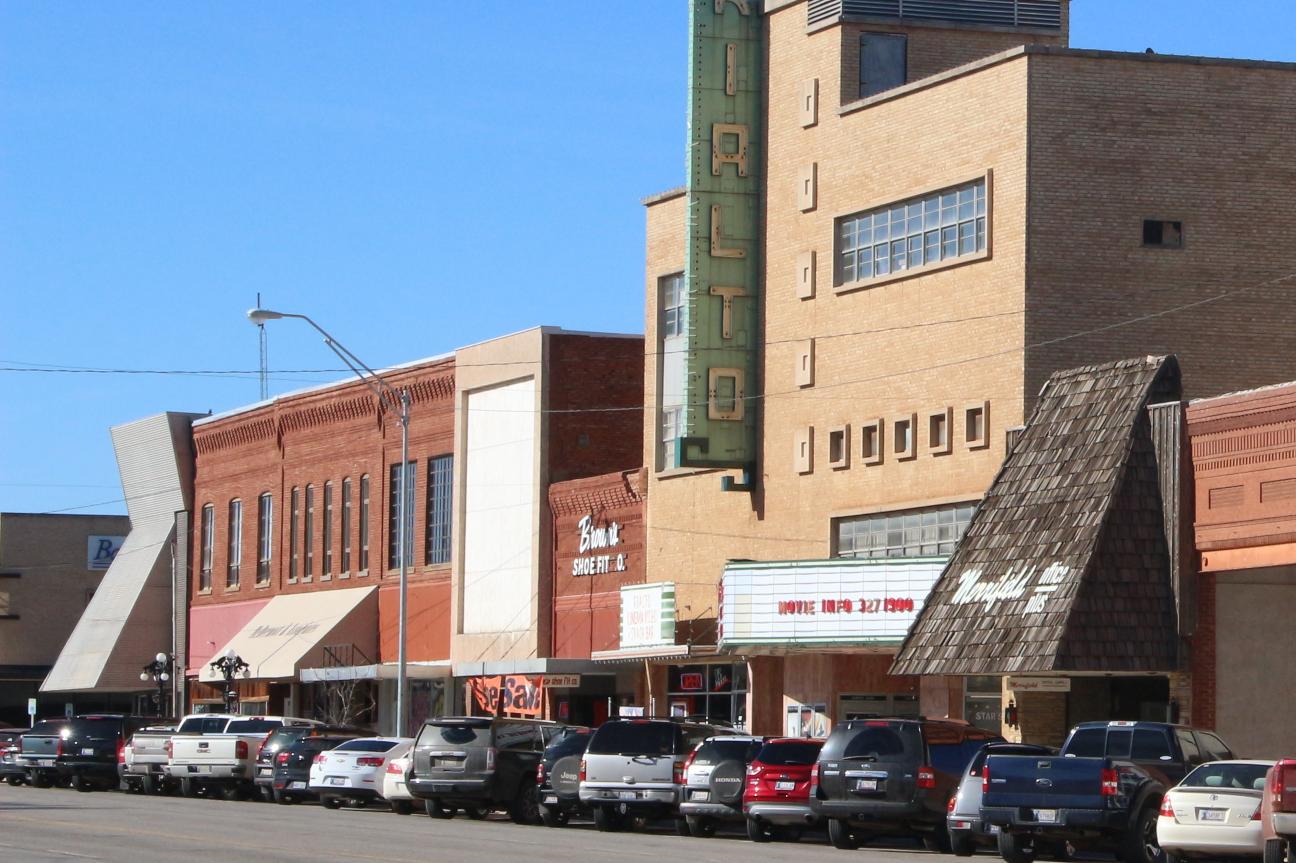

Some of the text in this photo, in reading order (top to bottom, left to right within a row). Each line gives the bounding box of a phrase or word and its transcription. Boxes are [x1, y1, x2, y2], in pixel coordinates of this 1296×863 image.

[572, 558, 595, 577] SHOE
[597, 555, 610, 573] FIT
[778, 600, 816, 615] MOVIE
[821, 598, 852, 614] INFO
[560, 771, 577, 781] Jeep
